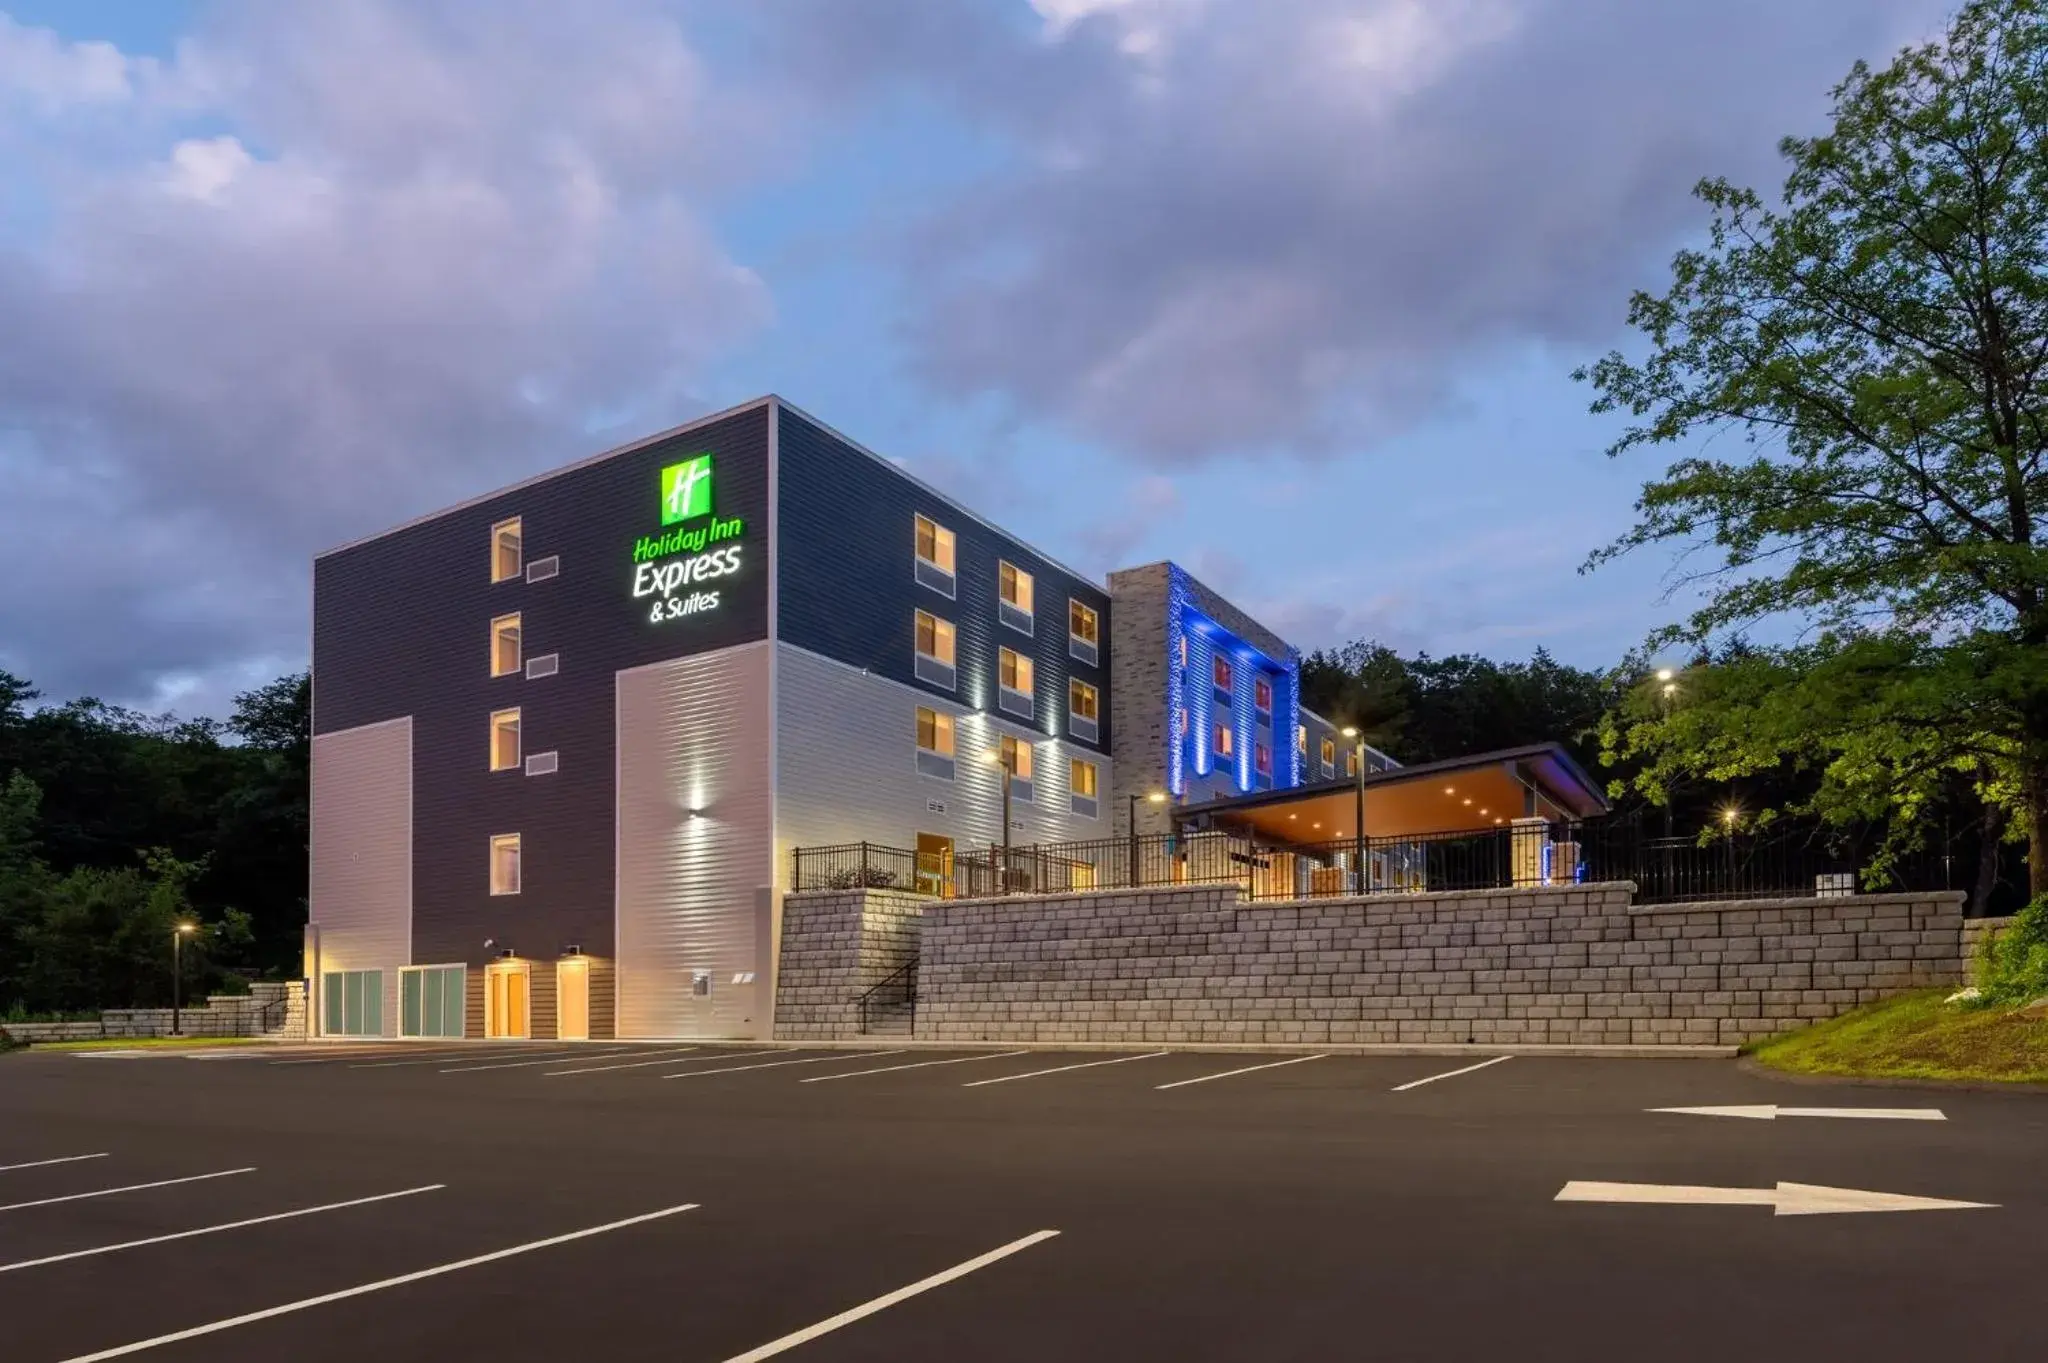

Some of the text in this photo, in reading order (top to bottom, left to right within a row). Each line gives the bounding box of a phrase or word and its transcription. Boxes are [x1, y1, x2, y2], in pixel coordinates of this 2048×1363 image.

[634, 517, 742, 562] Holiday Inn
[633, 546, 741, 598] Express
[650, 591, 720, 623] & Suites
